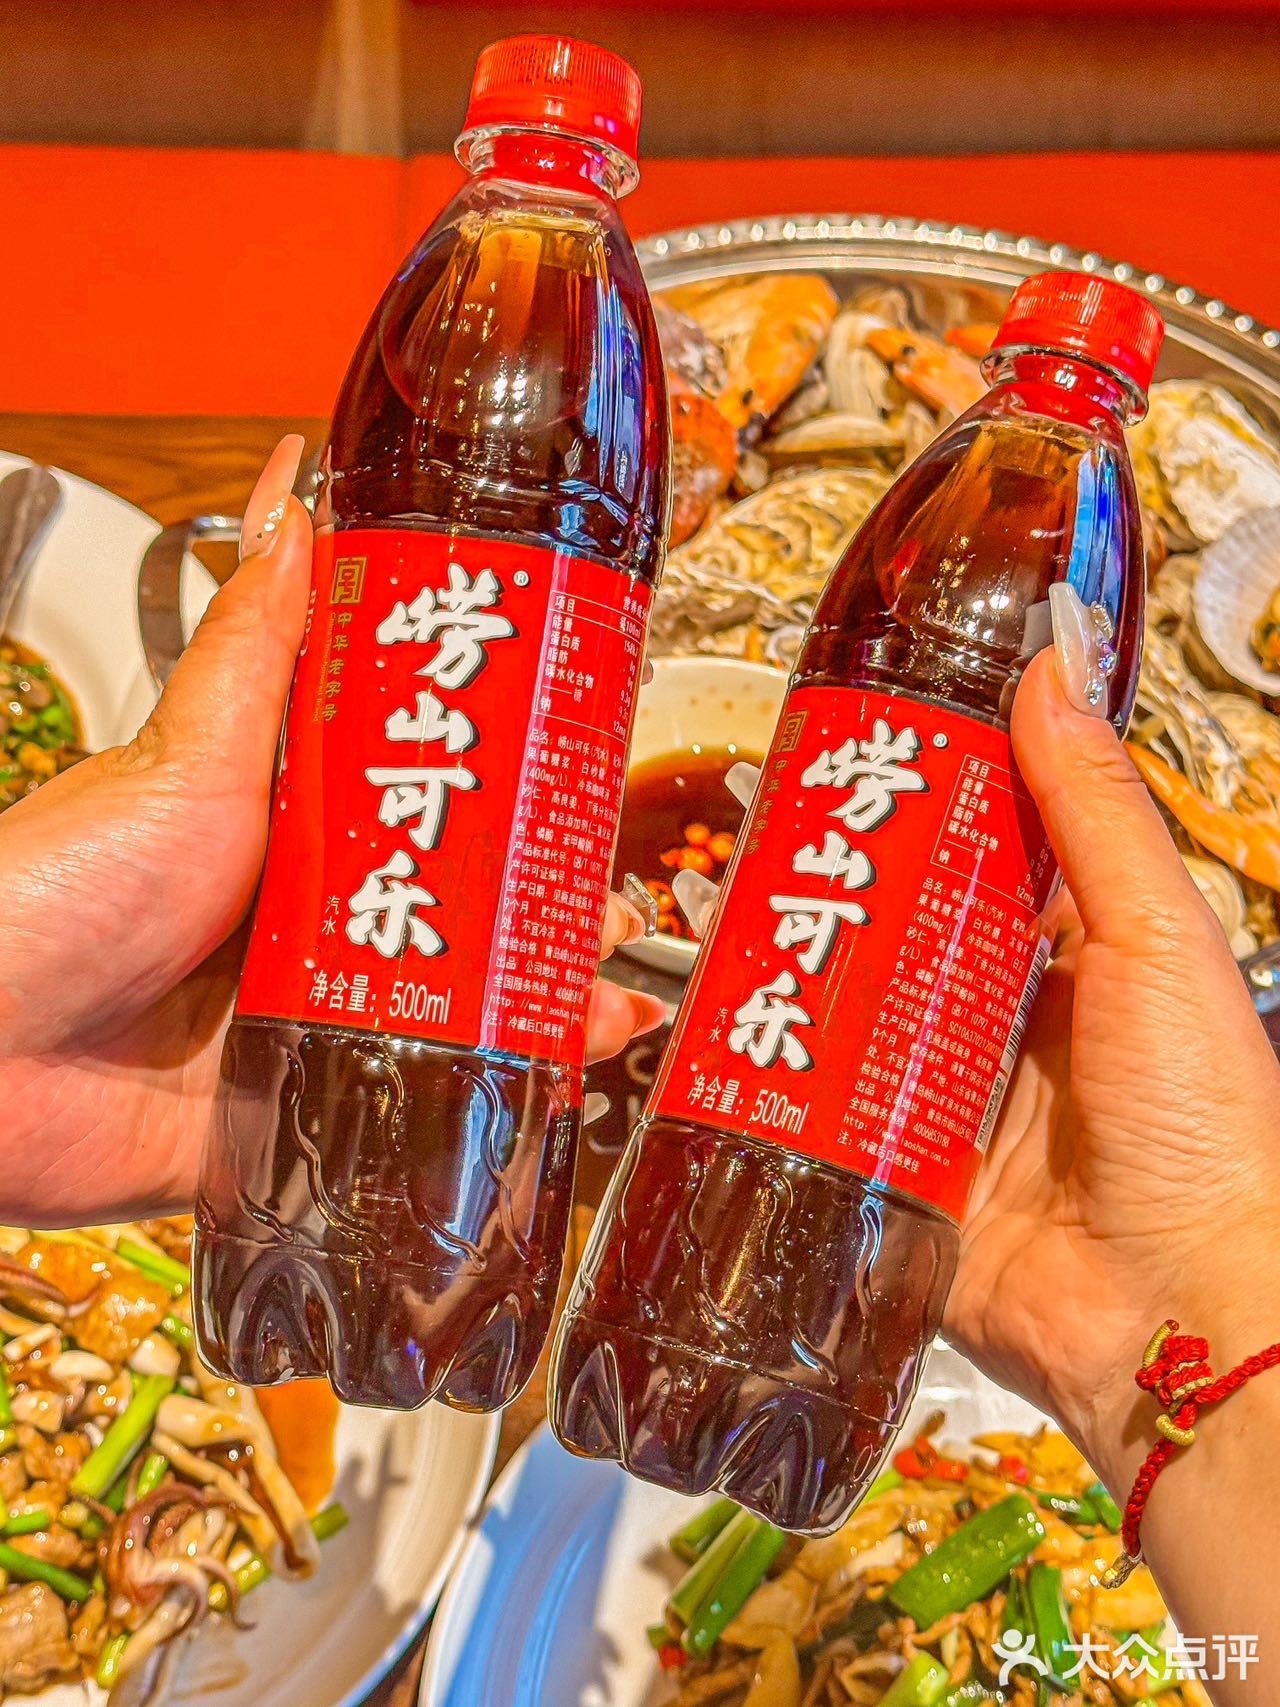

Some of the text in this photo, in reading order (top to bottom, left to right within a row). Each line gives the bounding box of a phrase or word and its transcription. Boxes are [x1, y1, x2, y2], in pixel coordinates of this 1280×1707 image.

[555, 596, 575, 612] 项目
[552, 615, 572, 632] 能量
[551, 630, 581, 651] 蛋白质
[321, 611, 352, 721] 中华老字号
[547, 648, 568, 665] 脂肪
[545, 663, 595, 688] 碳水化合物
[344, 562, 517, 958] 崂山可乐
[968, 760, 990, 778] 项目
[962, 777, 984, 795] 能量
[958, 791, 990, 814] 蛋白质
[952, 805, 975, 824] 脂肪
[948, 820, 999, 851] 碳水化合物
[939, 848, 1035, 907] 钠 12mg
[728, 718, 928, 1071] 崂山可乐
[321, 895, 341, 935] 汽水
[498, 936, 537, 955] 检验合格
[495, 955, 517, 969] 出品
[708, 1007, 729, 1043] 汽水
[871, 1027, 898, 1047] 9个月
[859, 1062, 901, 1087] 检验合格
[854, 1079, 876, 1097] 出品
